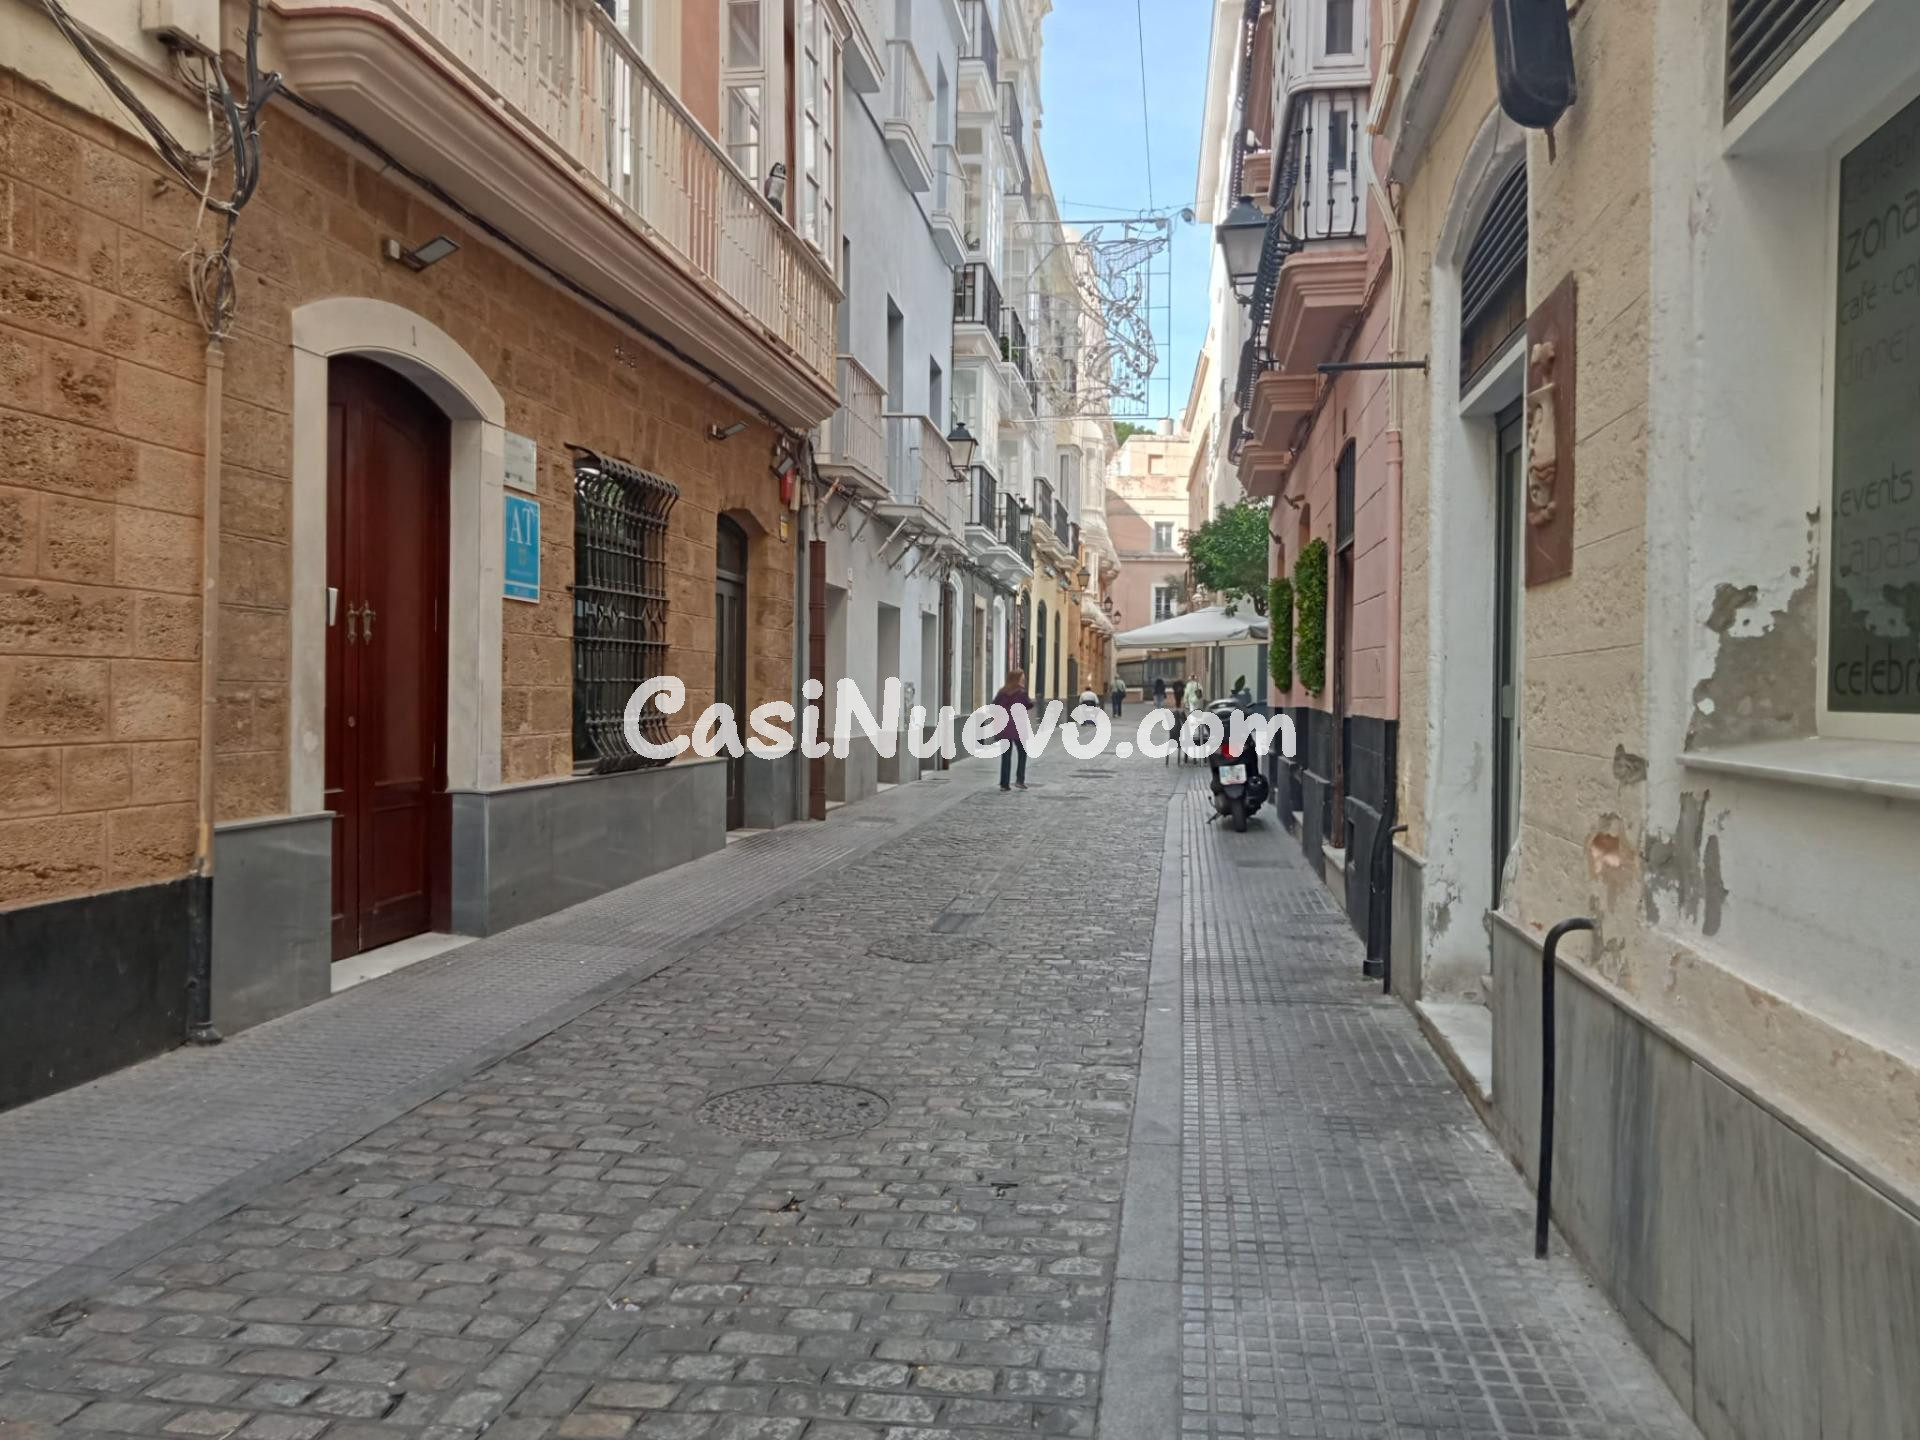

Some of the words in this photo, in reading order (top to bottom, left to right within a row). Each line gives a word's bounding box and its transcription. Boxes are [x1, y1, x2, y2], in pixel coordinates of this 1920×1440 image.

[1844, 188, 1920, 273] zona
[1839, 460, 1915, 518] events
[509, 505, 537, 546] AT
[1833, 642, 1920, 696] celebr
